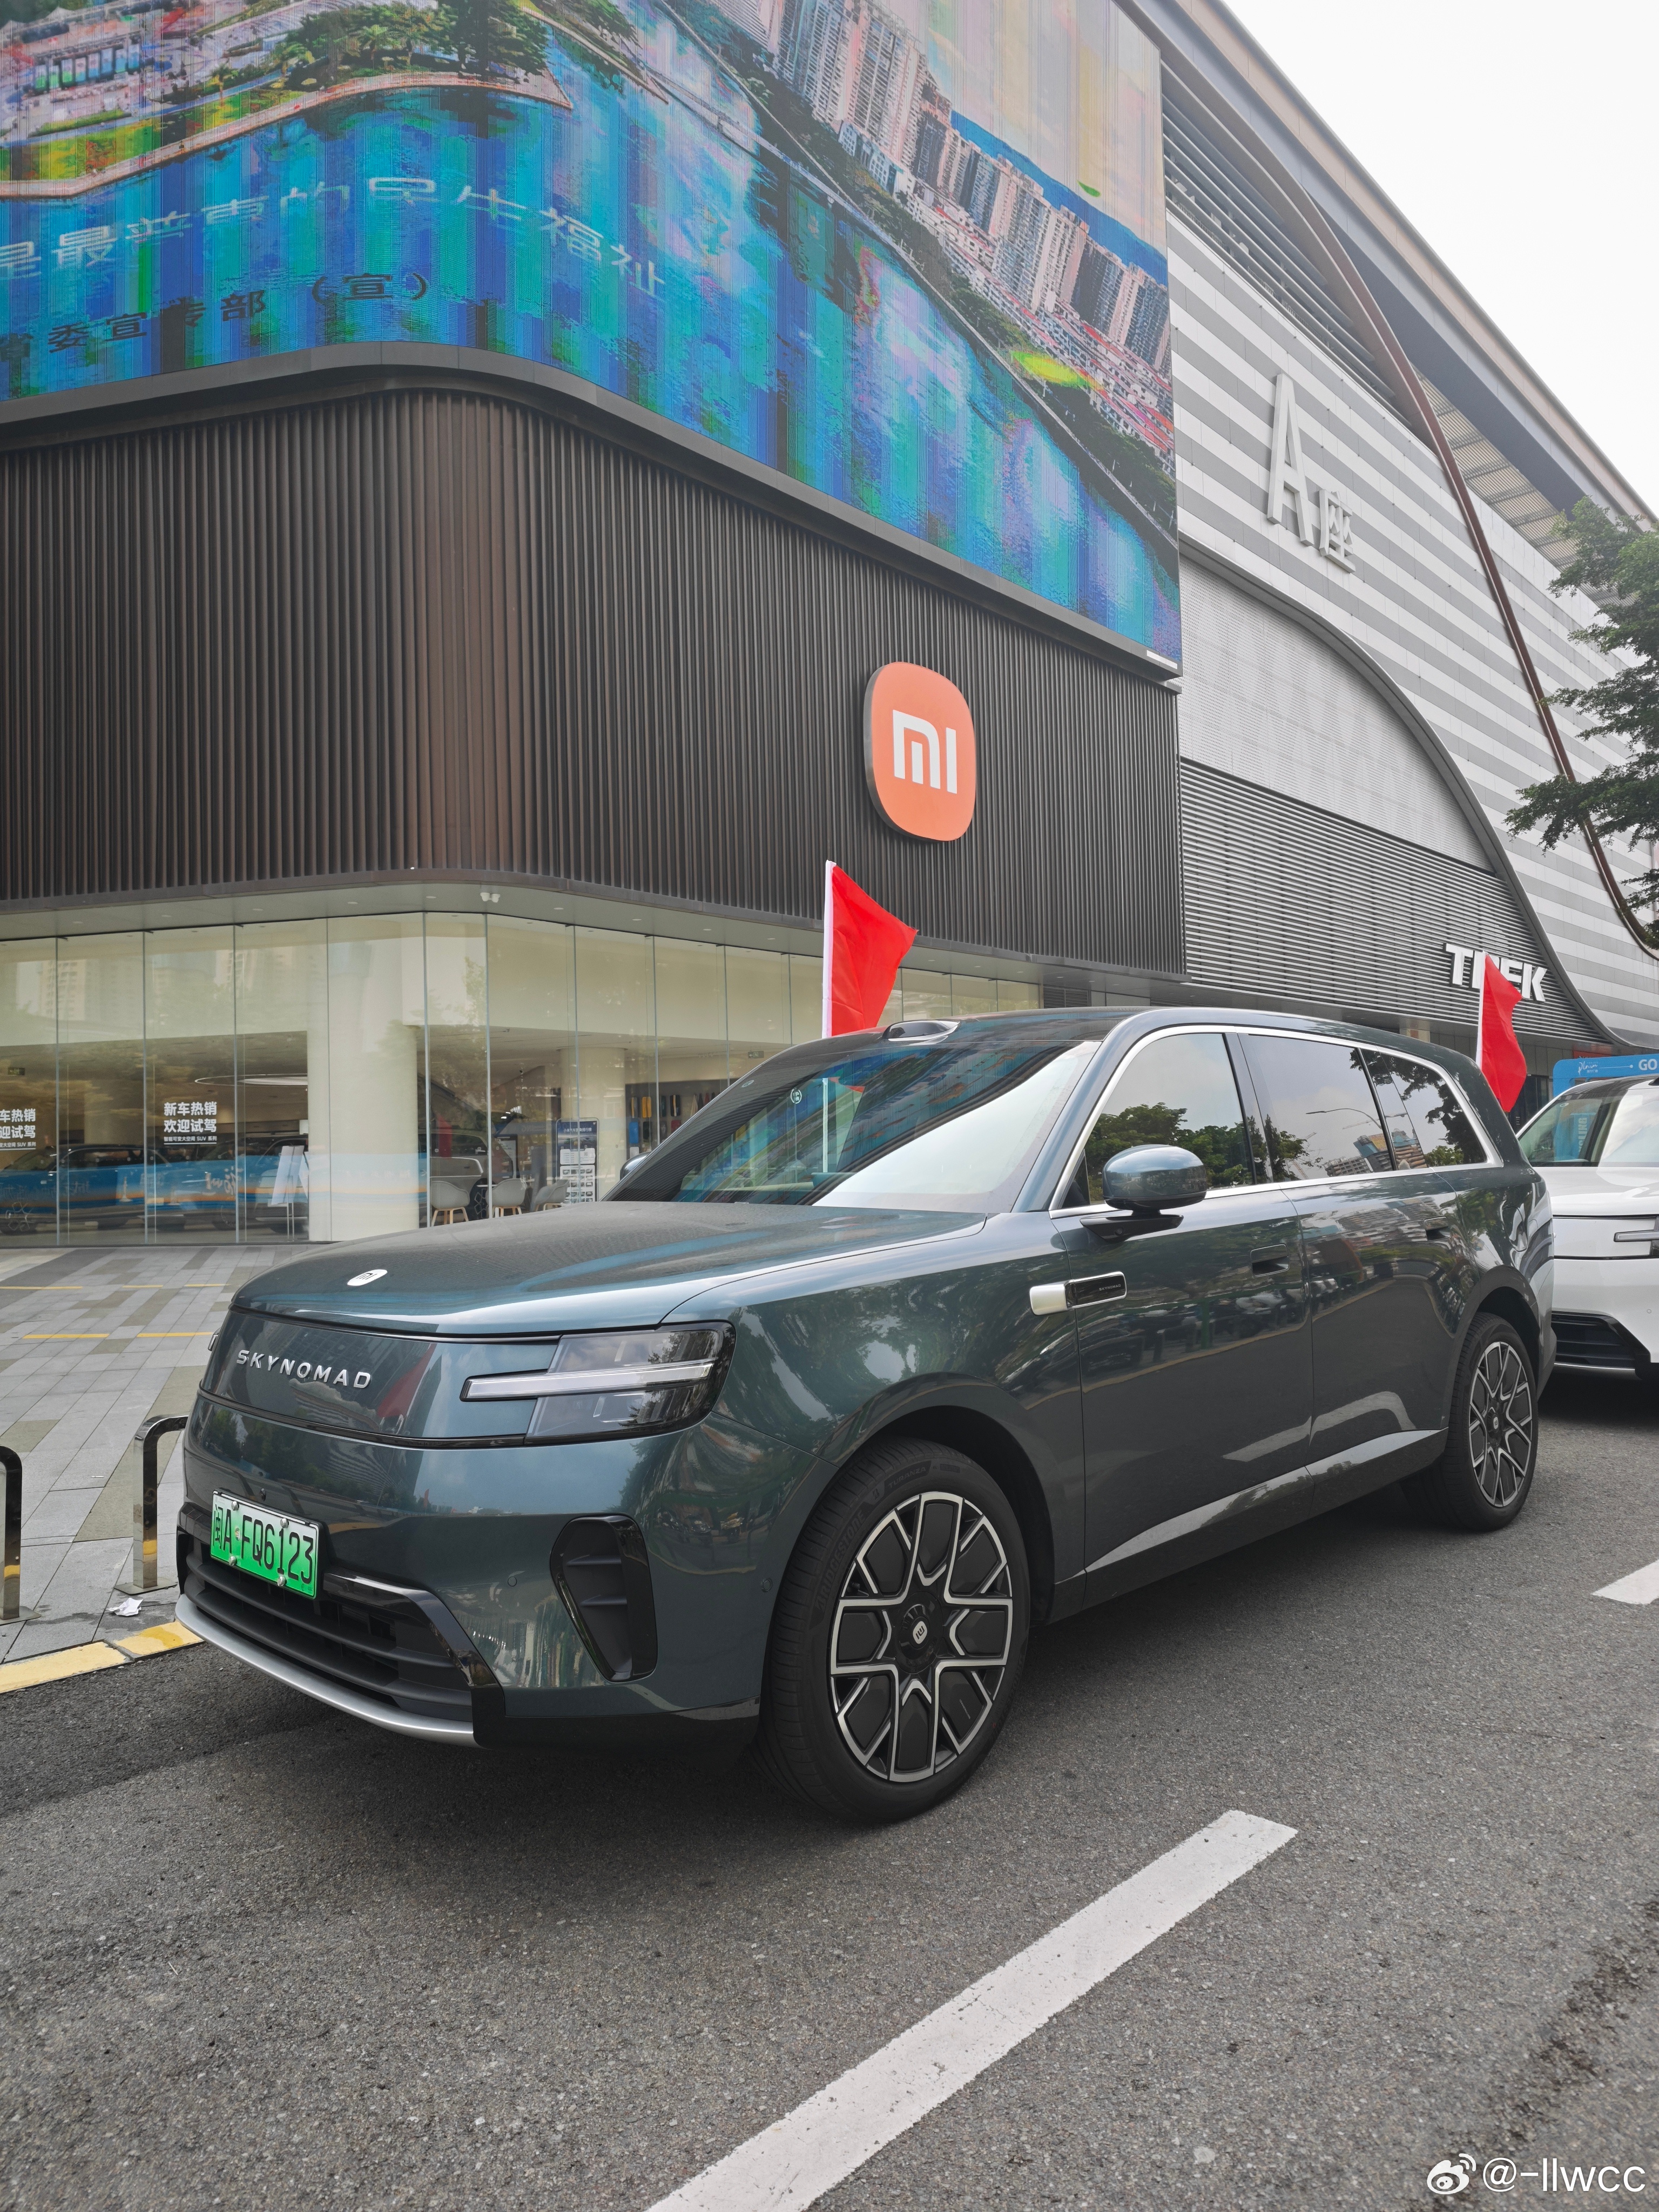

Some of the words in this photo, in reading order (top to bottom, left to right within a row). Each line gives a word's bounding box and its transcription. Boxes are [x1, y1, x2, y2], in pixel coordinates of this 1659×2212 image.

[1267, 373, 1356, 574] A座
[1638, 1058, 1657, 1070] GO
[0, 1108, 36, 1123] 车热销
[164, 1101, 217, 1116] 新车热销
[164, 1118, 217, 1132] 欢迎试驾
[237, 1350, 372, 1388] SKYNOMAD
